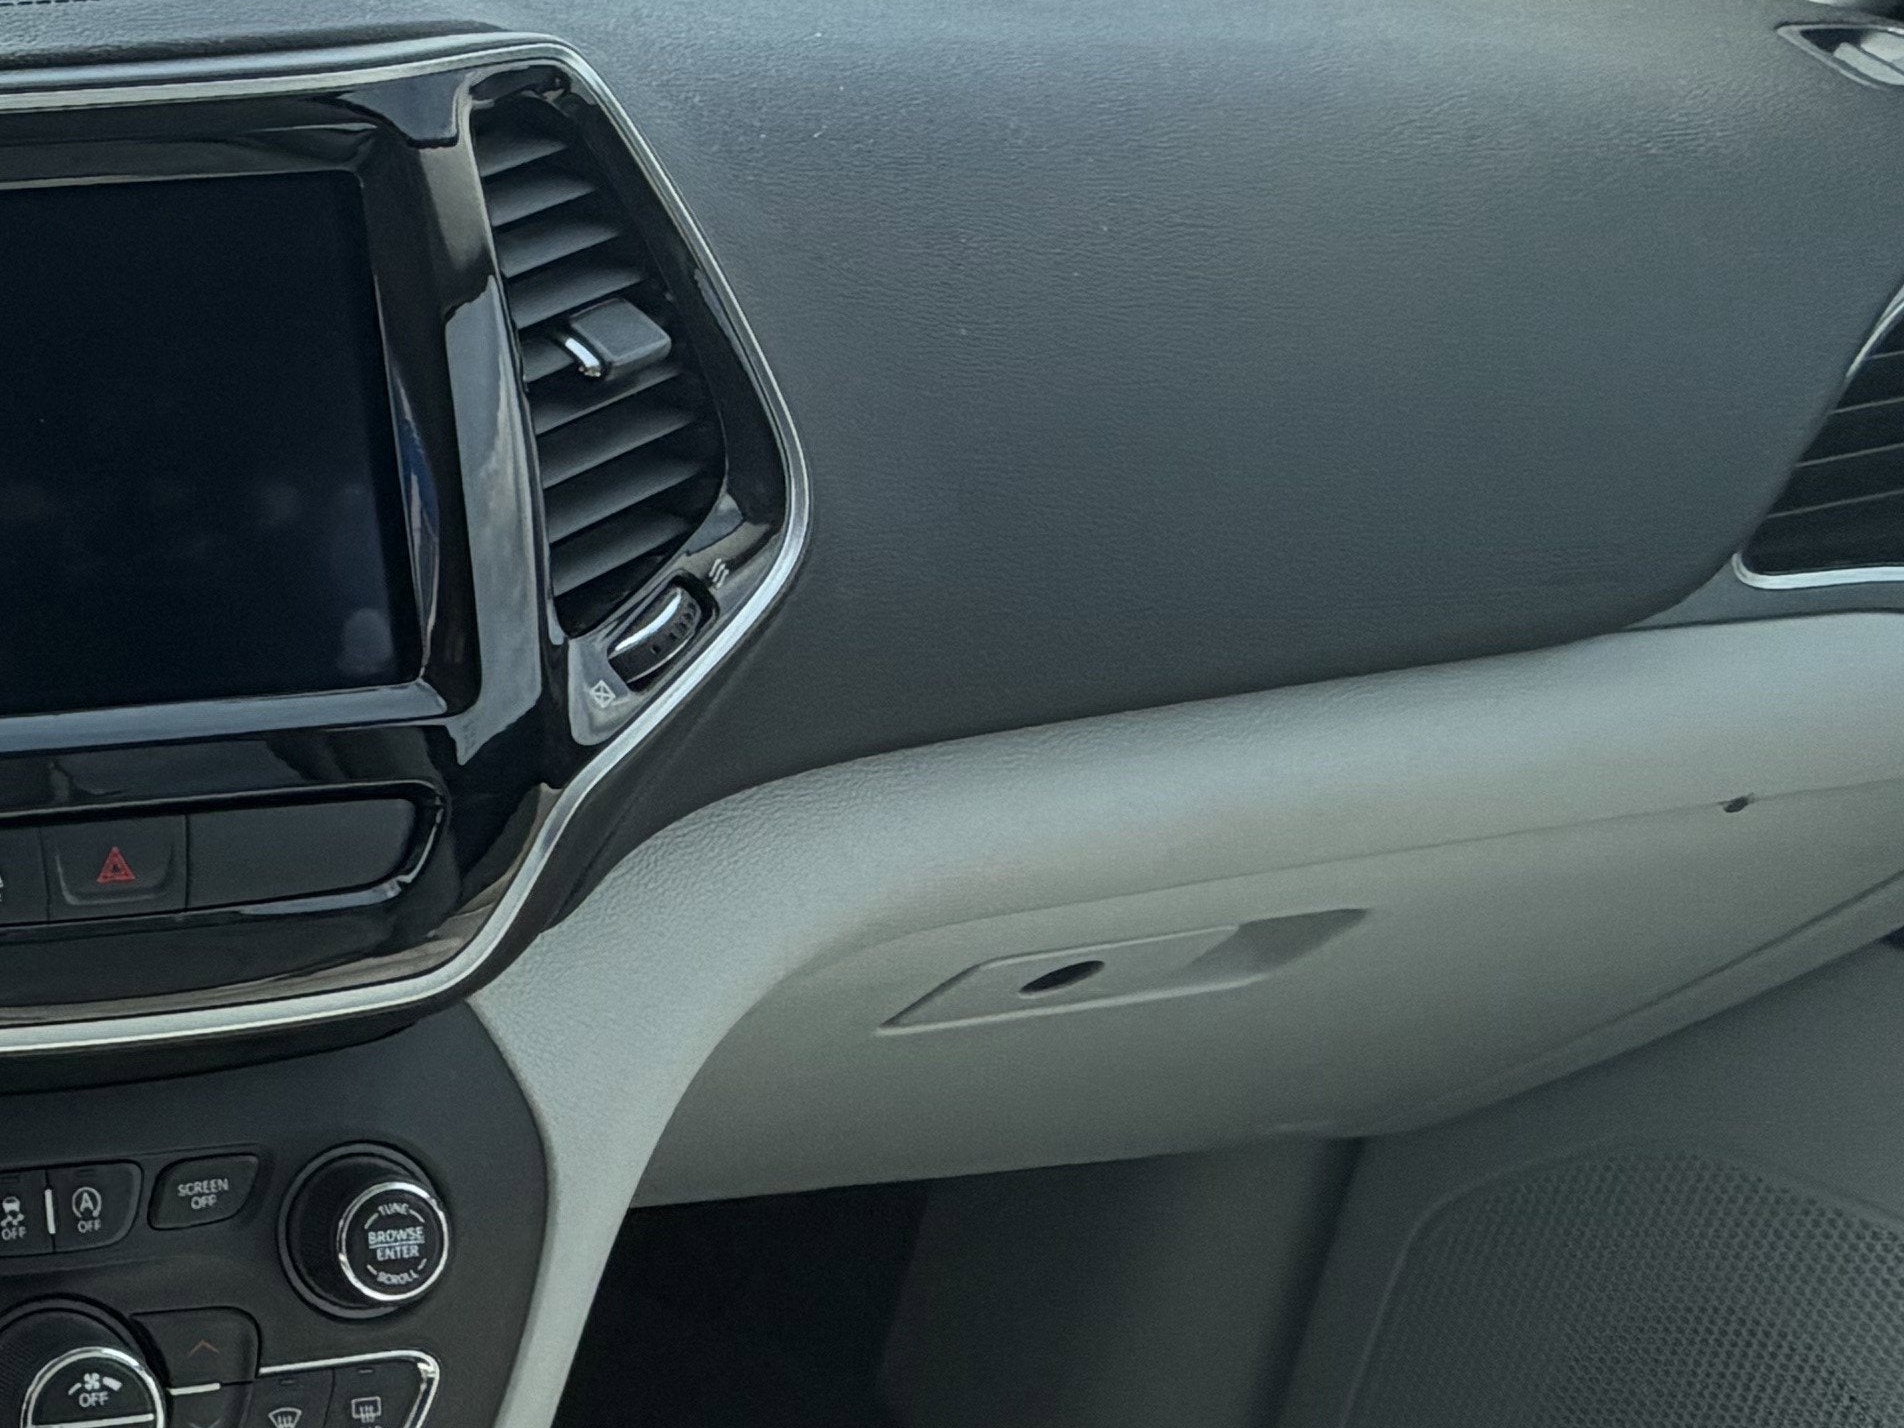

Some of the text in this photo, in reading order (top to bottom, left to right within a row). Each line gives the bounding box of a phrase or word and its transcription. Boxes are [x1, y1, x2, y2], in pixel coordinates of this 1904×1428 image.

[177, 1177, 230, 1199] SCREEN
[190, 1193, 218, 1211] OFF
[1, 1226, 27, 1241] OFF
[76, 1218, 102, 1234] OFF
[367, 1226, 425, 1245] BROWSE
[376, 1245, 420, 1261] ENTER
[377, 1269, 419, 1285] SCROLL
[78, 1390, 110, 1408] OFF
